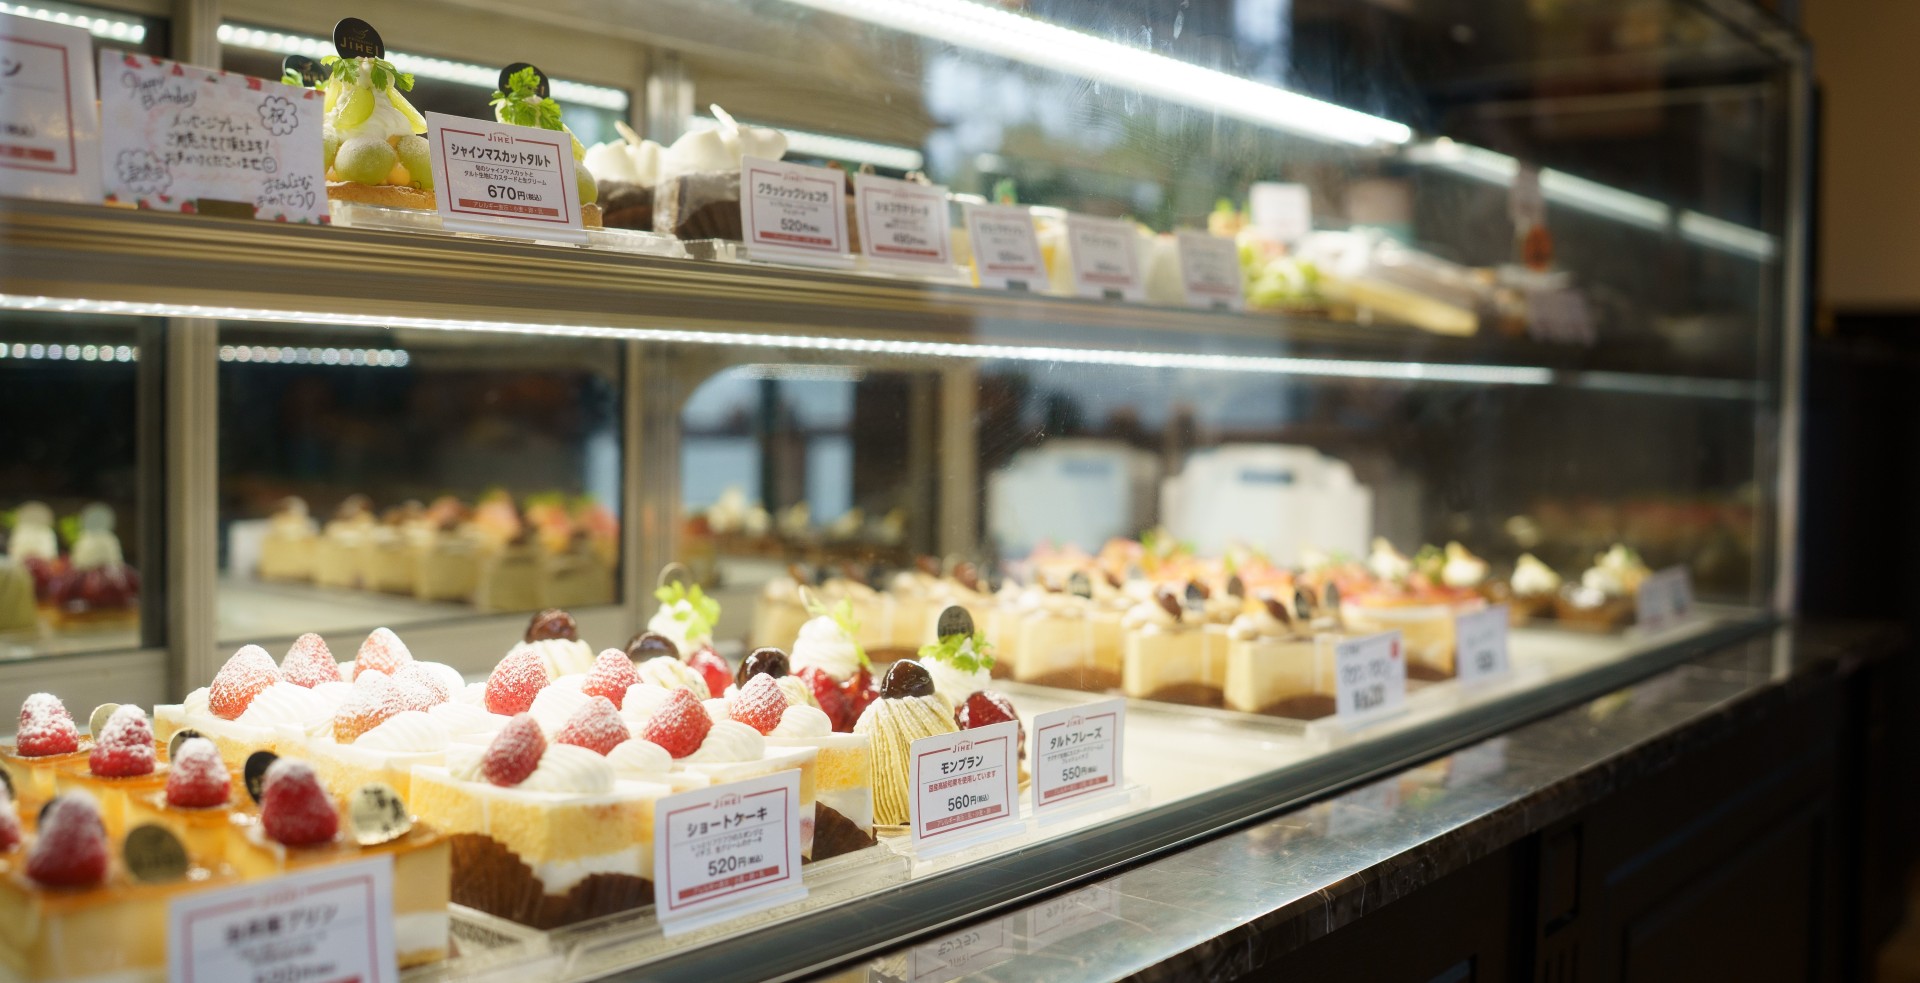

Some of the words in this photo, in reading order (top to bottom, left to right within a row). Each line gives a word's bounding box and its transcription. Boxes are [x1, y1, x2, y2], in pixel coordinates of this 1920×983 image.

[268, 107, 288, 124] 祝
[451, 143, 551, 168] シャインマスカットタルト
[1050, 726, 1102, 750] タルトフレーズ
[940, 755, 984, 775] モンブラン
[687, 807, 768, 838] ショートケーキ
